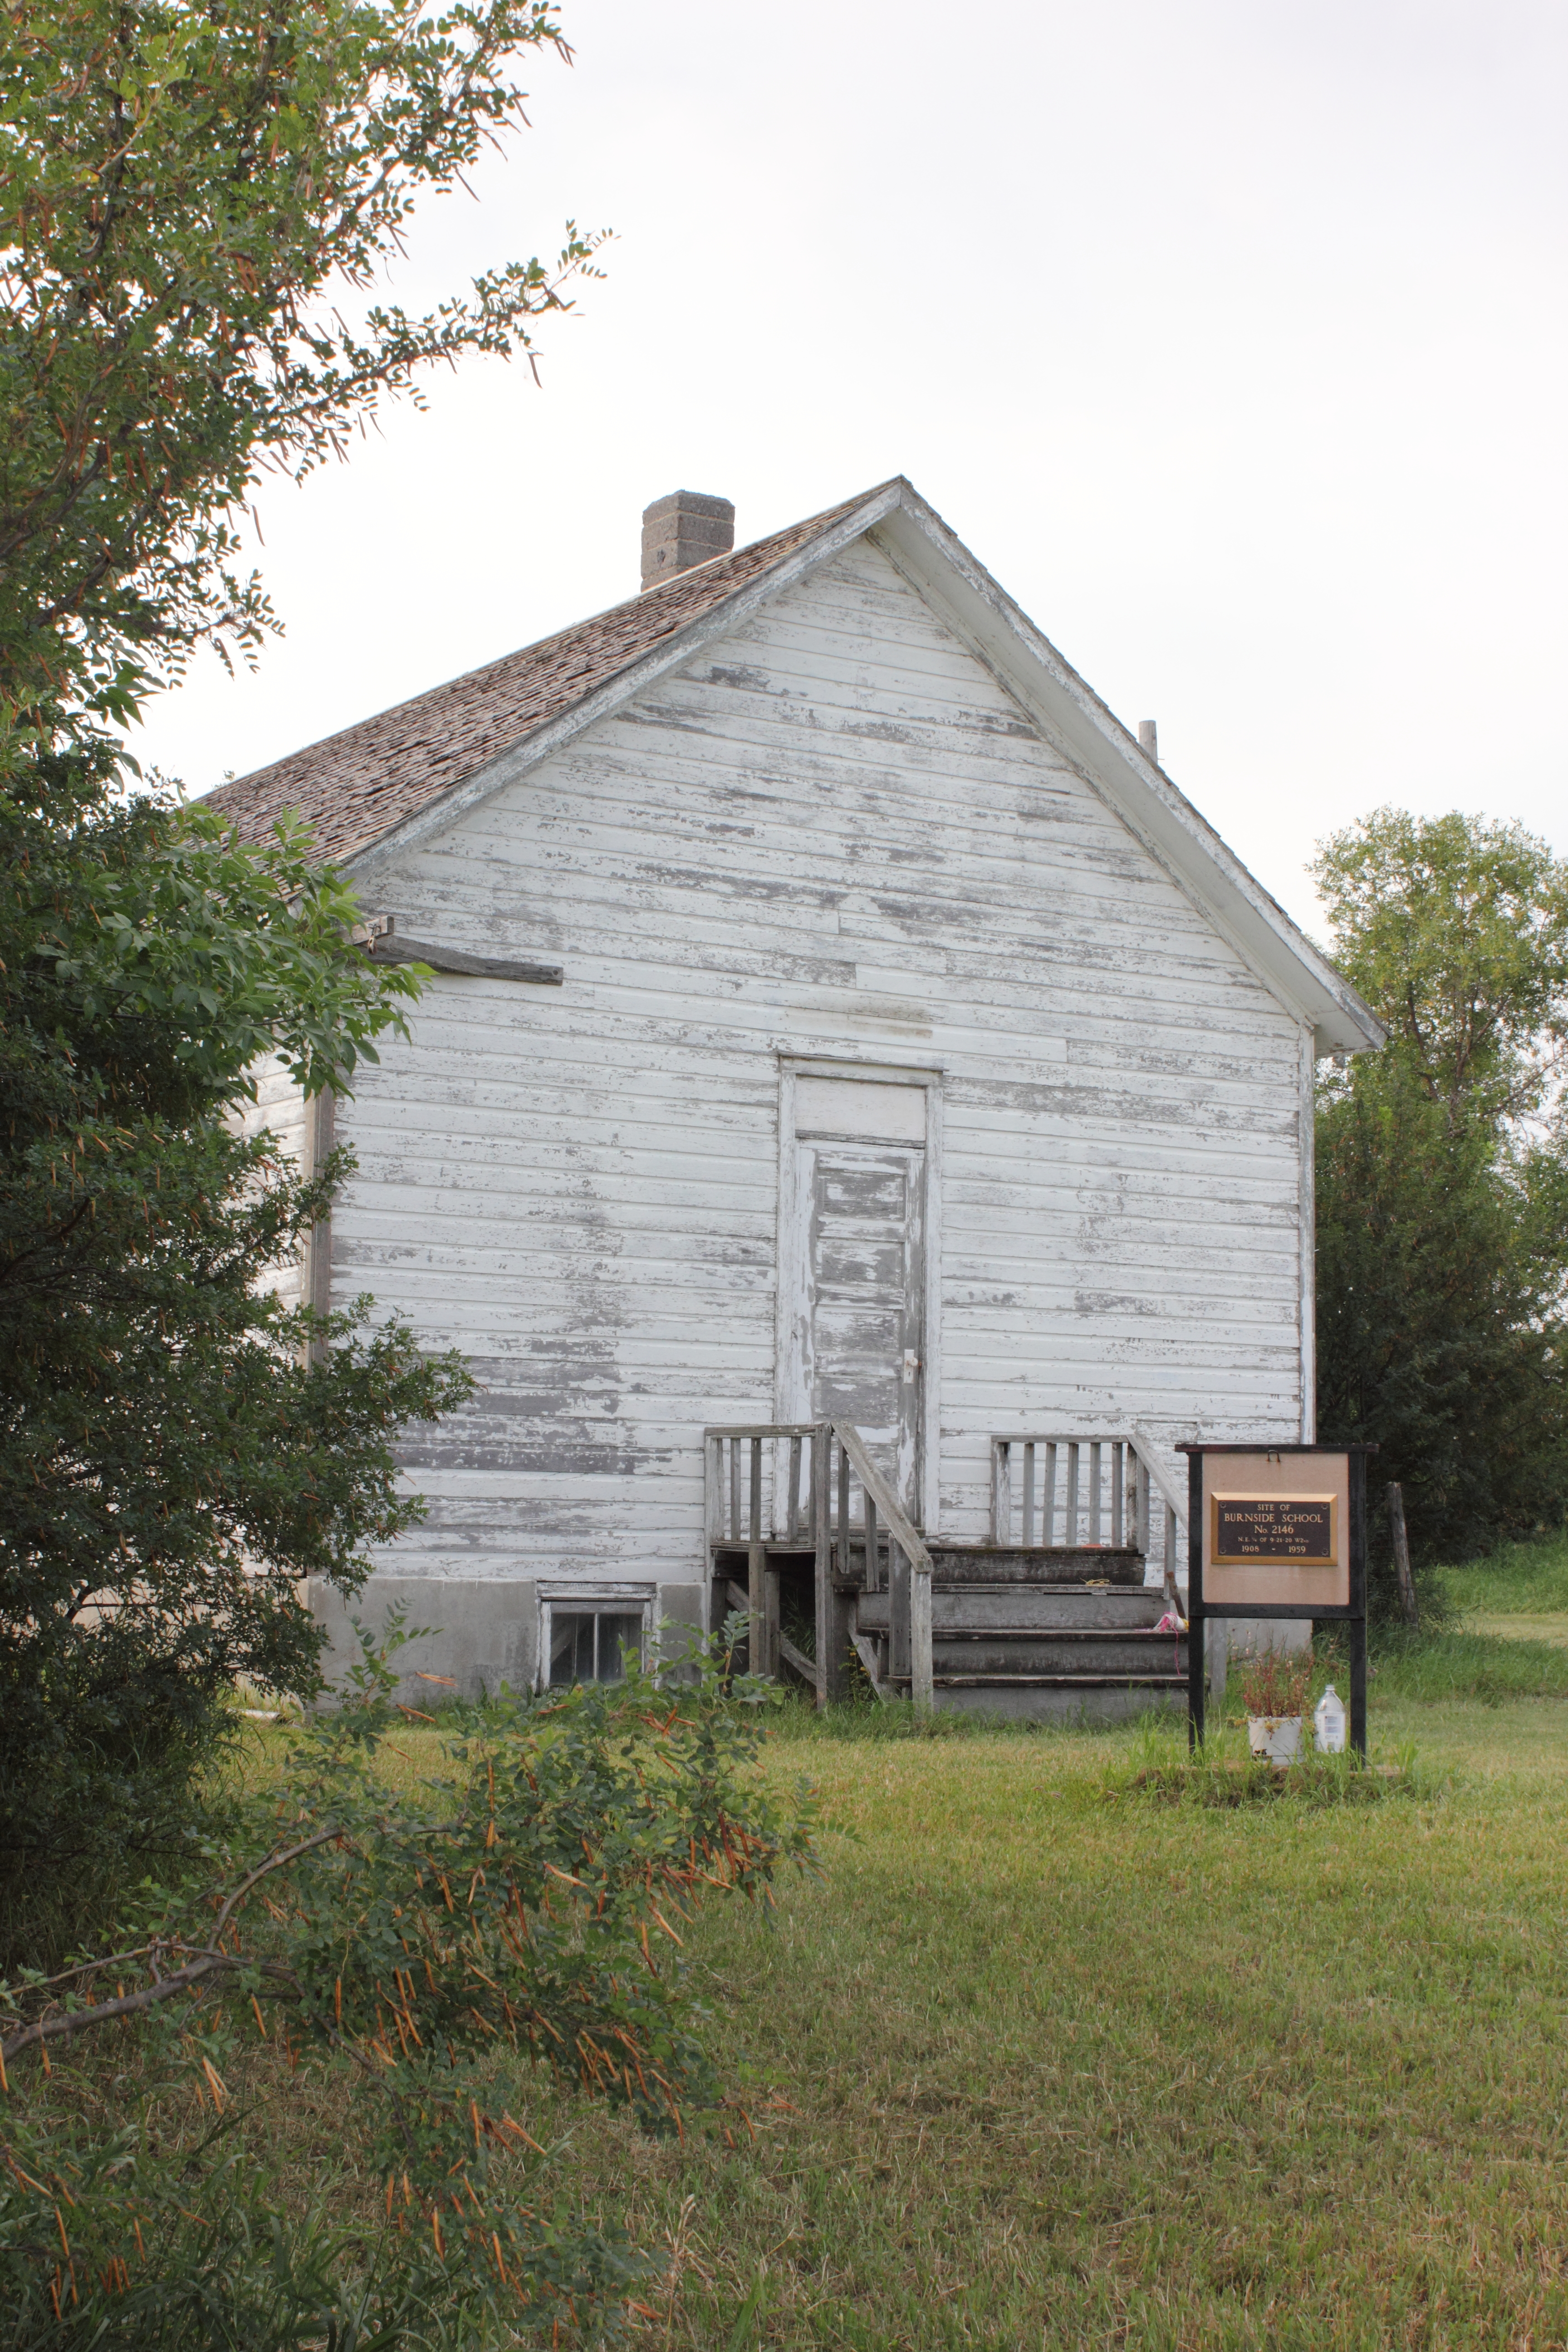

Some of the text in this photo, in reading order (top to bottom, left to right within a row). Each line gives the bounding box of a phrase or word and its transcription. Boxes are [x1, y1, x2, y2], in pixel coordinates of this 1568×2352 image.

[1224, 1513, 1323, 1523] BURNSIDE SCHOOL
[1254, 1524, 1294, 1534] No. 2146
